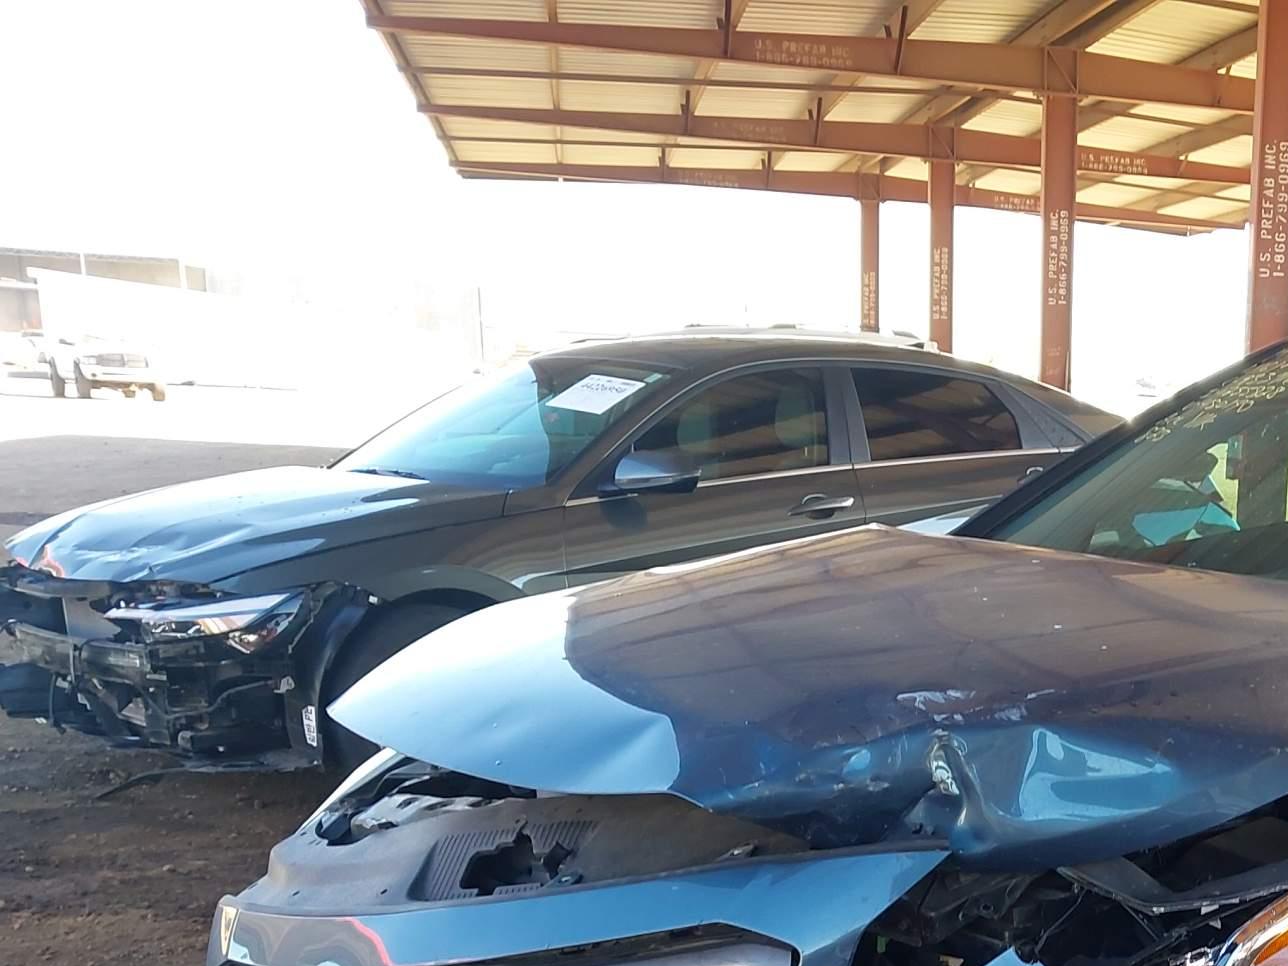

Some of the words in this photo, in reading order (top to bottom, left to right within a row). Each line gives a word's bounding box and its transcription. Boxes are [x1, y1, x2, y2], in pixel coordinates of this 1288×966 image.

[1263, 139, 1277, 170] INC.
[1260, 177, 1275, 240] PREFAB
[1048, 235, 1059, 279] PREFAB
[1259, 247, 1272, 278] U.S.
